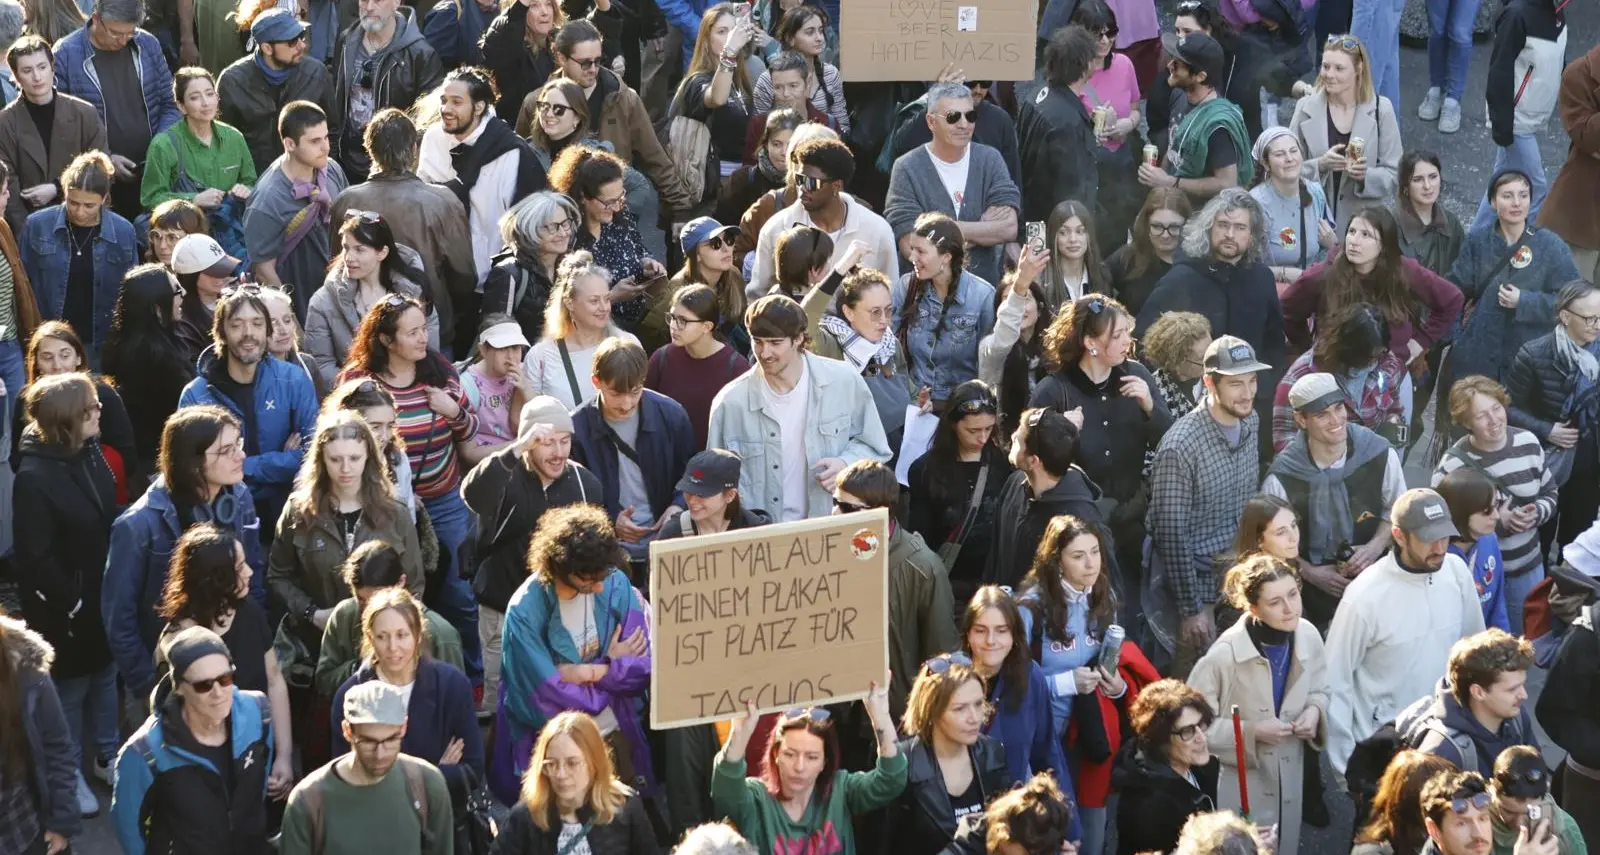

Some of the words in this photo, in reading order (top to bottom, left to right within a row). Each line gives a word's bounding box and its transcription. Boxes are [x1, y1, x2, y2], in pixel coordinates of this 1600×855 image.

[871, 40, 931, 62] HATE
[941, 40, 1020, 63] NAZIS
[896, 22, 954, 37] BEER
[658, 549, 723, 590] NICHT
[732, 541, 780, 578] MAL
[784, 532, 842, 569] AUF
[658, 586, 749, 626] MEINEM
[762, 570, 848, 614] PLAKAT
[675, 631, 713, 667] IST
[725, 617, 798, 658] PLATZ
[809, 607, 858, 645] FÜR
